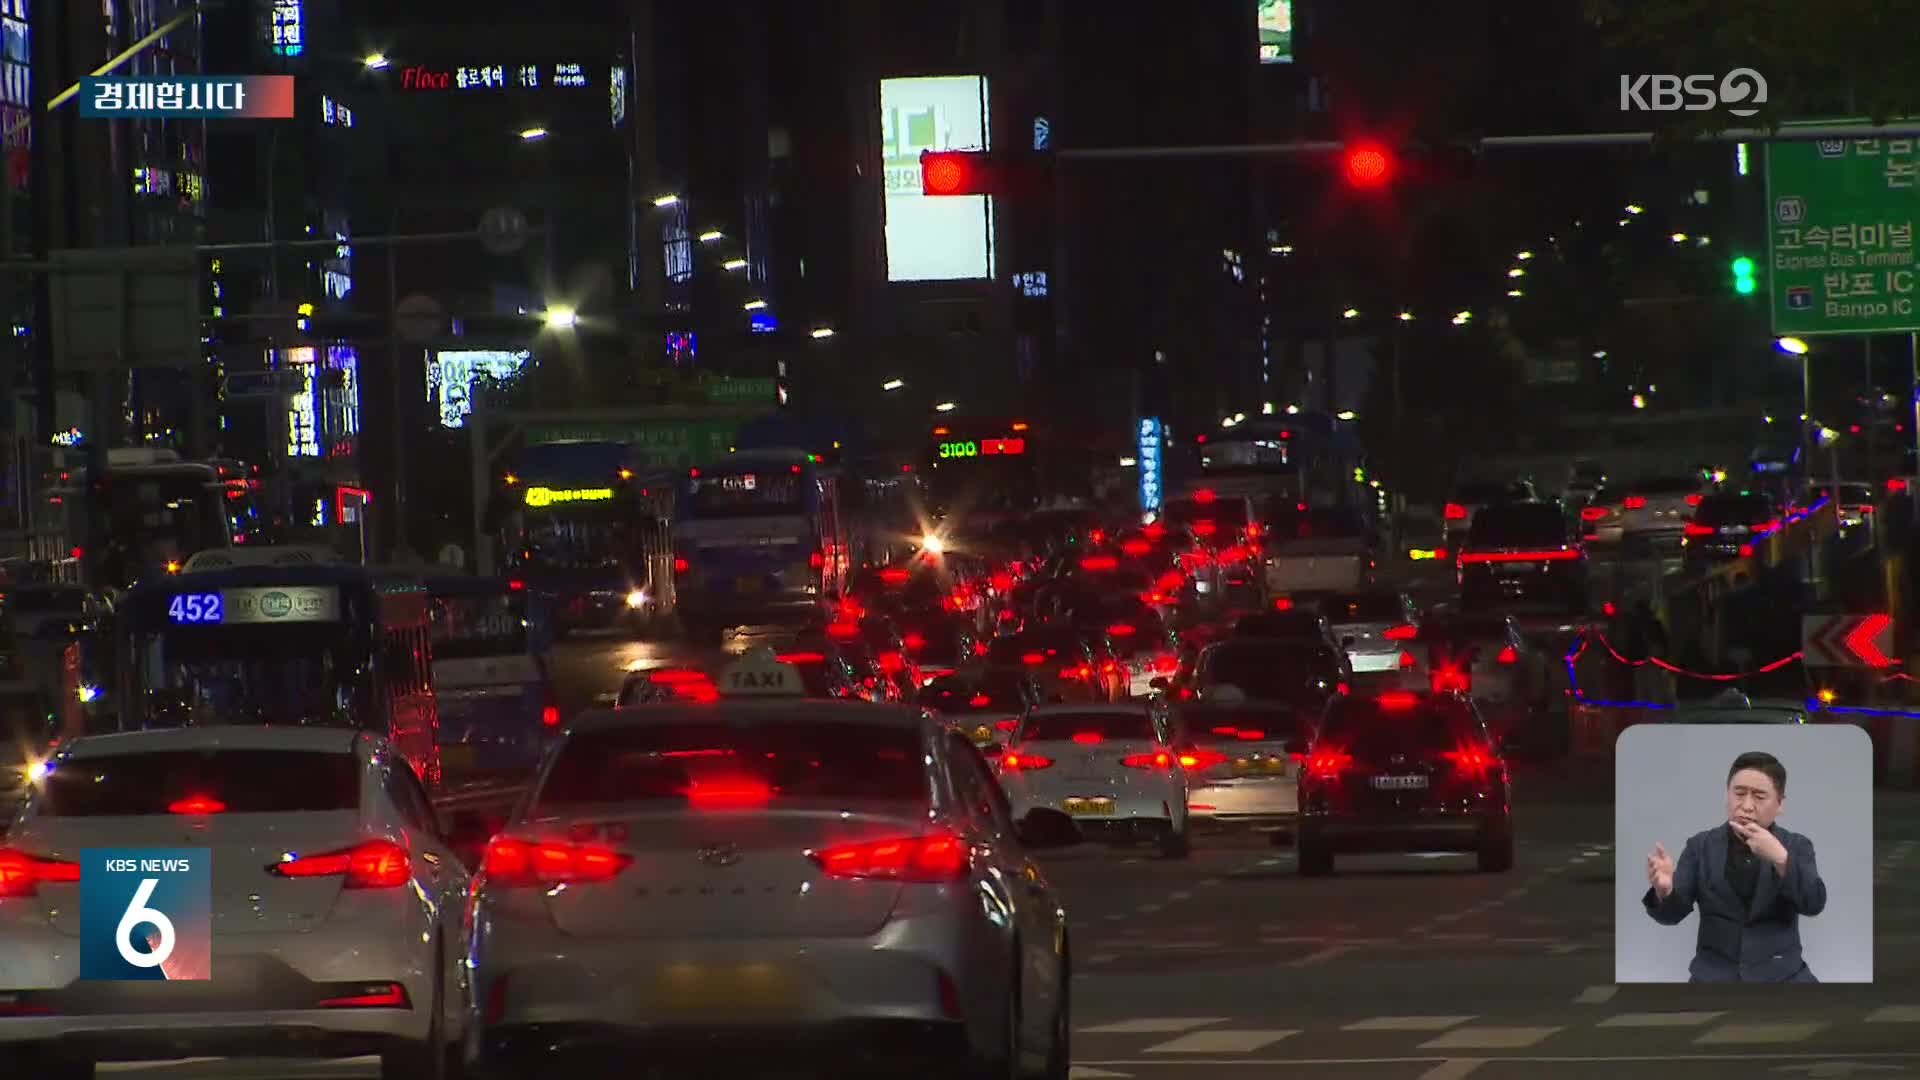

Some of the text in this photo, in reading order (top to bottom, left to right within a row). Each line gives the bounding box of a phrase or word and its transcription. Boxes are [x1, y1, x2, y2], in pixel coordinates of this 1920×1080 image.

[1775, 221, 1912, 251] 고속터미널
[1775, 254, 1825, 269] Express
[1830, 252, 1856, 267] Bus
[1823, 271, 1913, 298] 반포 IC
[1825, 299, 1912, 317] Banpo IC
[939, 441, 977, 458] 3100
[168, 594, 221, 621] 452
[729, 671, 784, 688] TAXI
